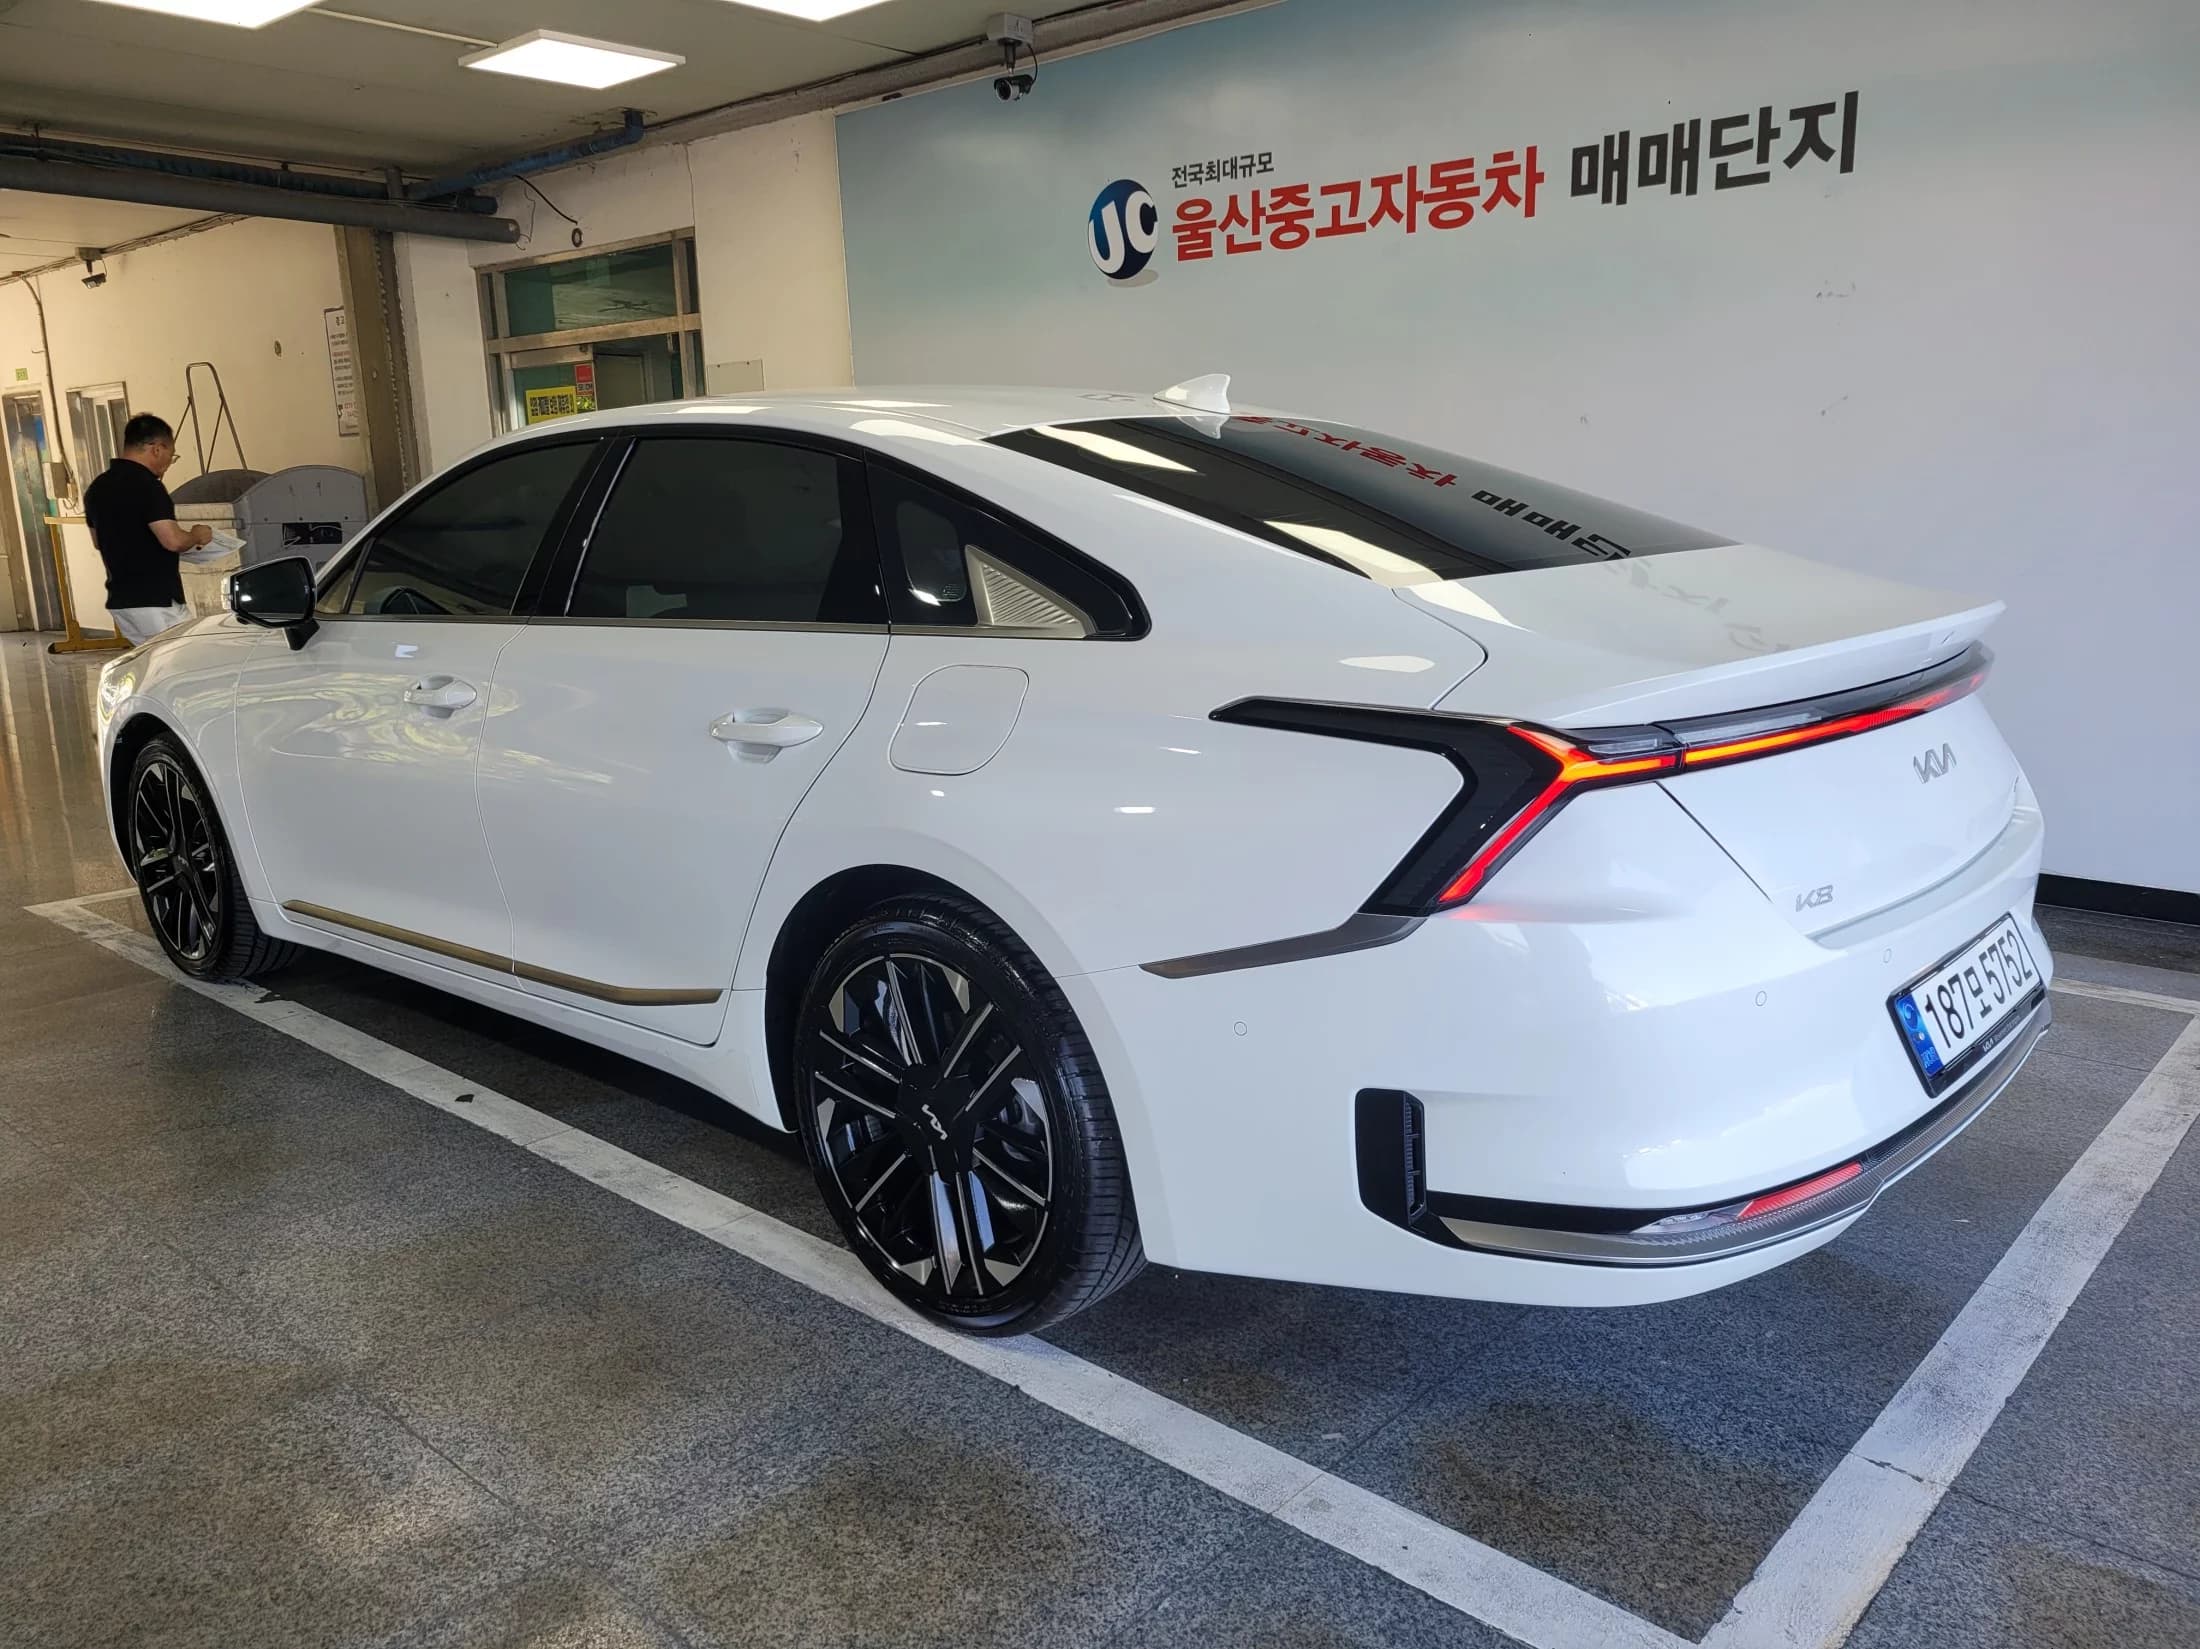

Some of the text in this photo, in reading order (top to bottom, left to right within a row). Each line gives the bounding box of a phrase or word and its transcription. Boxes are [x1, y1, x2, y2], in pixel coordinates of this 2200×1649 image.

[1171, 151, 1275, 189] 전국최대규모
[1172, 90, 1859, 262] 울산중고자동차 매매단지
[1913, 742, 1957, 784] KIA
[1795, 884, 1834, 912] K8
